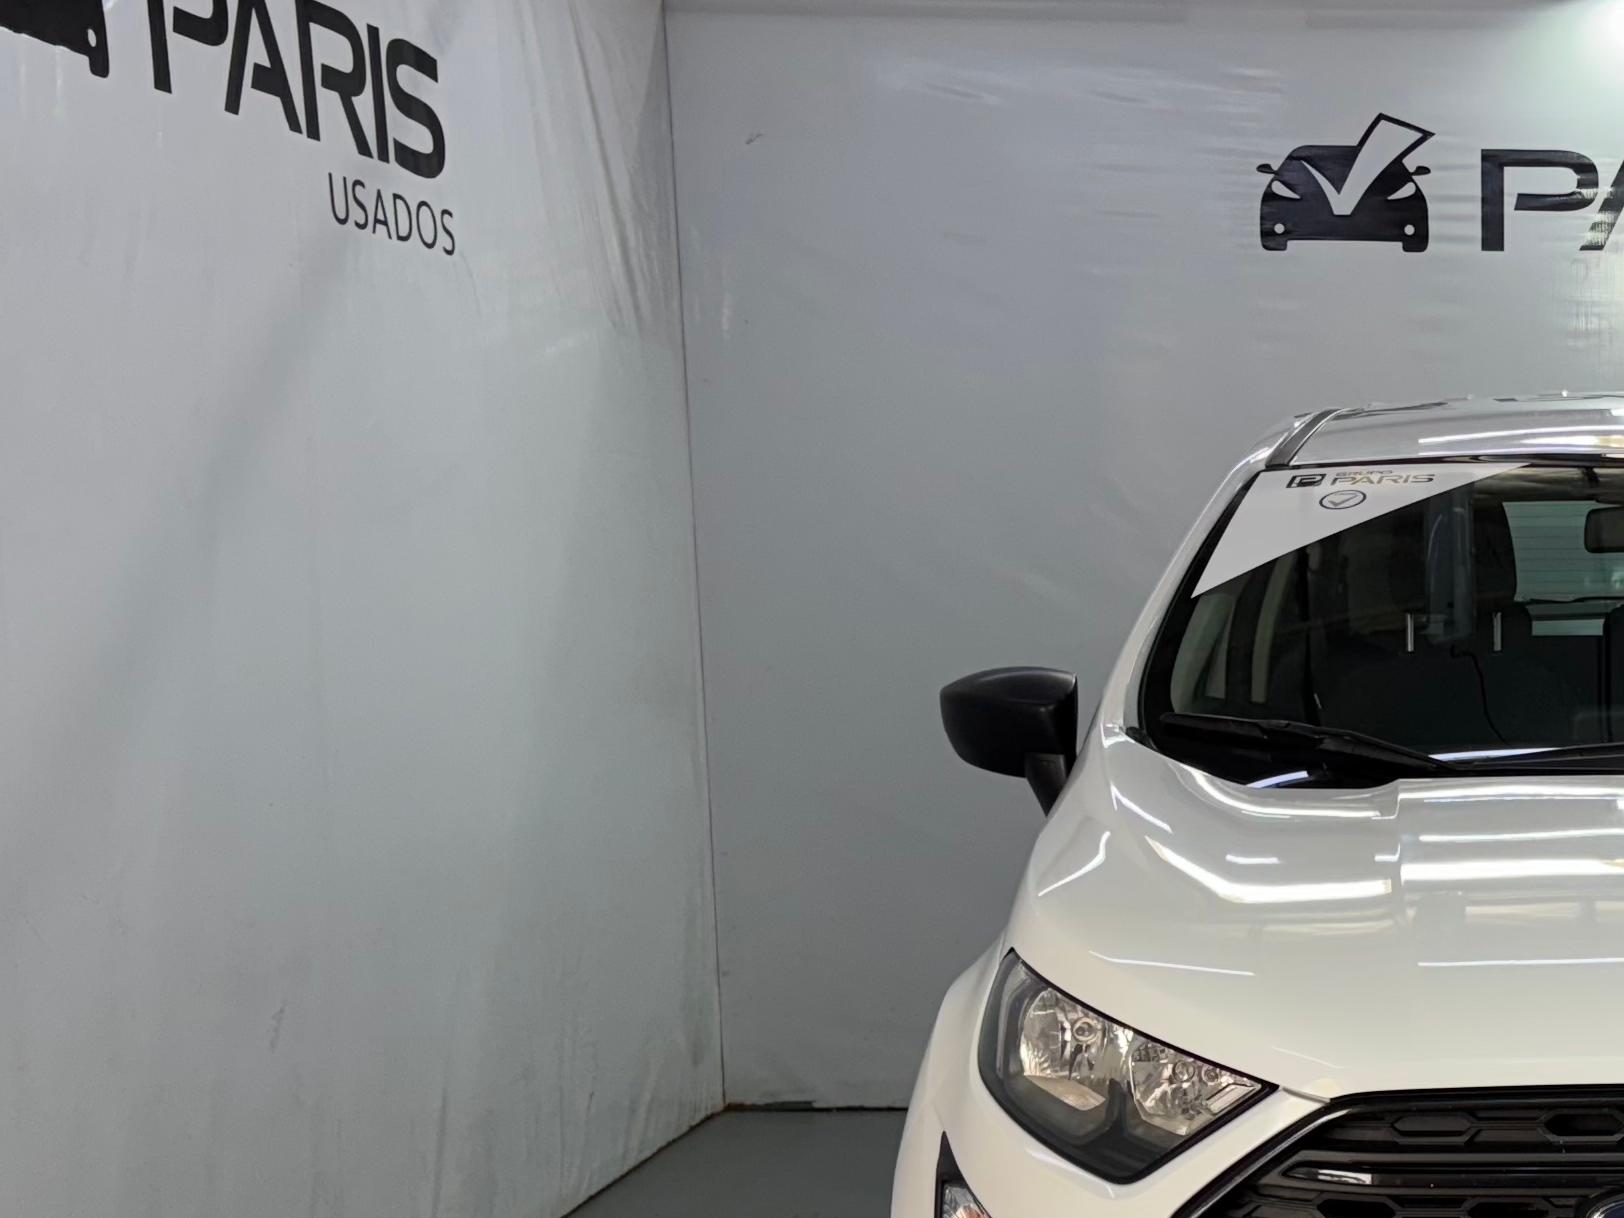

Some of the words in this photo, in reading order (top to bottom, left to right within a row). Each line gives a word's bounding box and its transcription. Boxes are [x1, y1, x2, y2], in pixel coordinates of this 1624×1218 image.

[147, 0, 446, 179] PARIS
[327, 172, 456, 256] USADOS
[1330, 473, 1435, 486] PARIS
